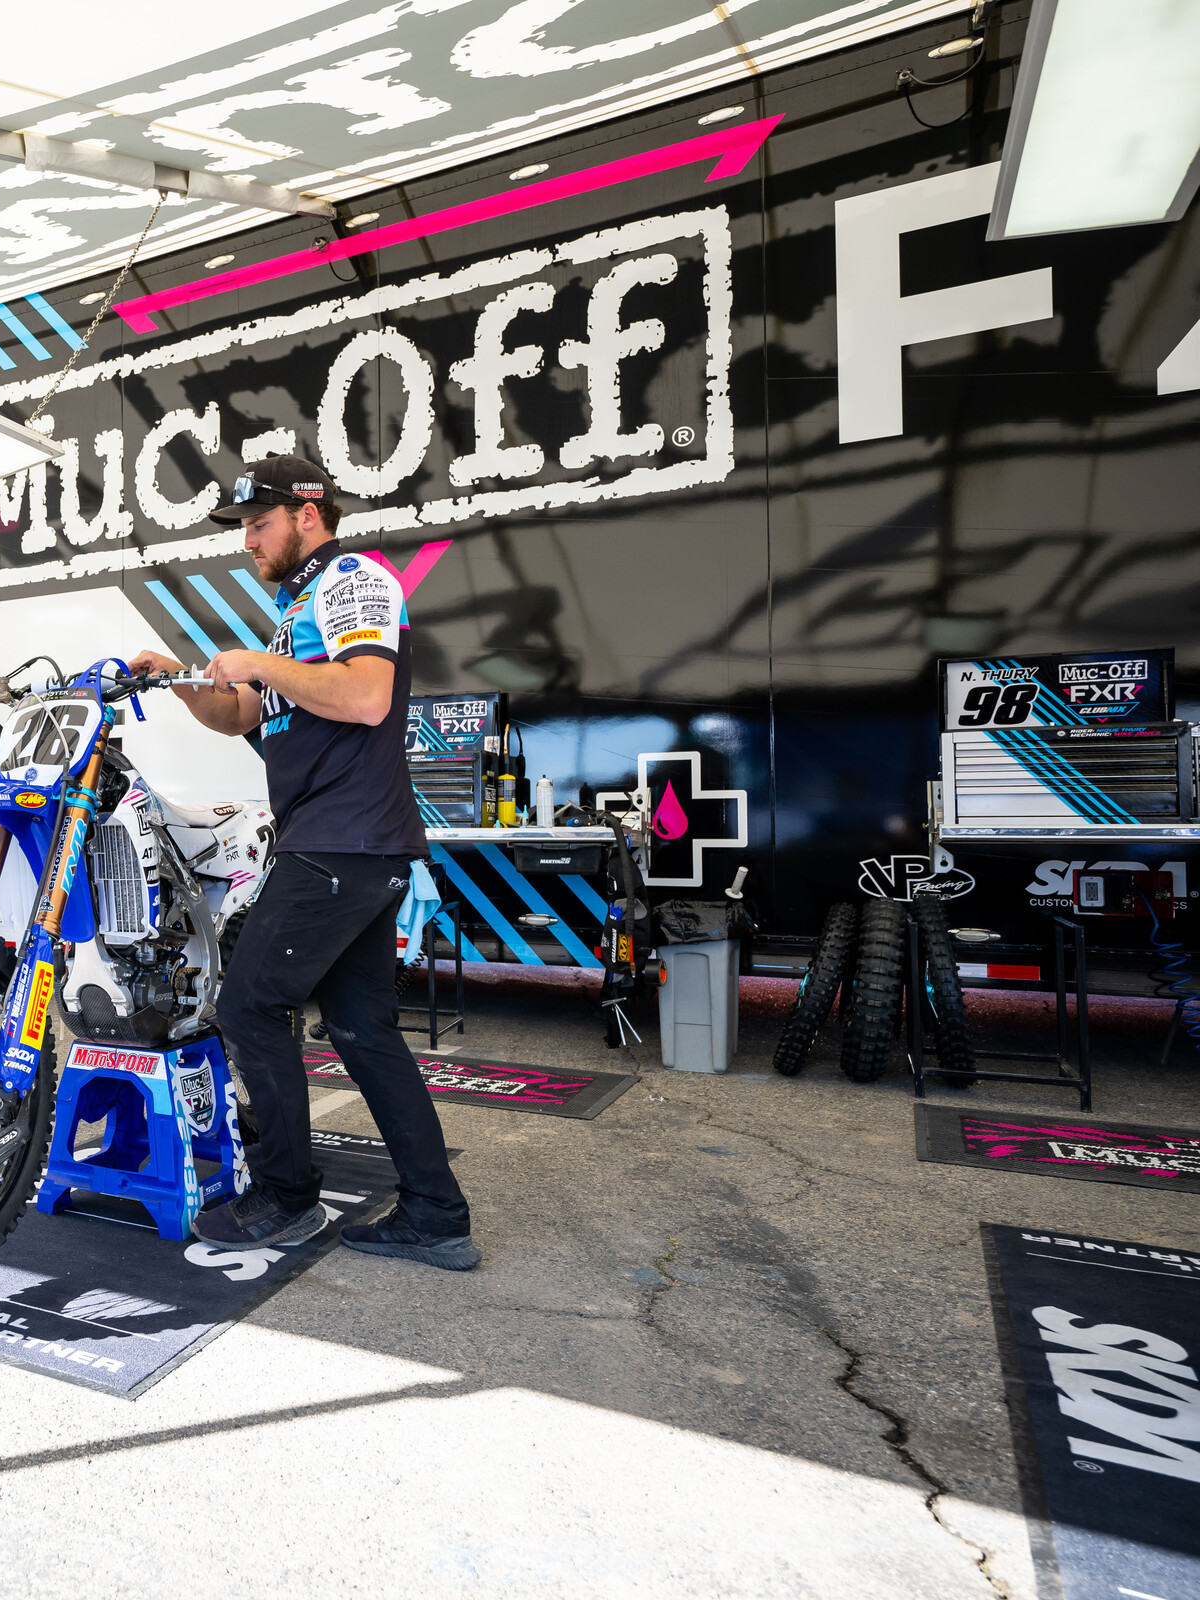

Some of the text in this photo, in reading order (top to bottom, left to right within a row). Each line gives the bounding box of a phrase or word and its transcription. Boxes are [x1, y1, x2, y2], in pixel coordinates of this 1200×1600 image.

[300, 482, 324, 491] YAMAHA
[292, 558, 321, 584] FXR
[341, 631, 378, 644] PIRELLI
[982, 667, 1040, 681] THURY
[1063, 662, 1144, 681] Muc-Off
[1070, 683, 1136, 702] FXR
[435, 703, 485, 716] Muc-Off
[958, 683, 1040, 727] 98
[1079, 706, 1128, 714] CLUBMX
[440, 718, 480, 733] FXR
[0, 704, 89, 772] 26
[16, 793, 47, 806] FMF
[859, 855, 938, 902] VP
[912, 879, 974, 894] Racing
[26, 968, 53, 1041] PIRELLI
[5, 1046, 35, 1064] SKDA
